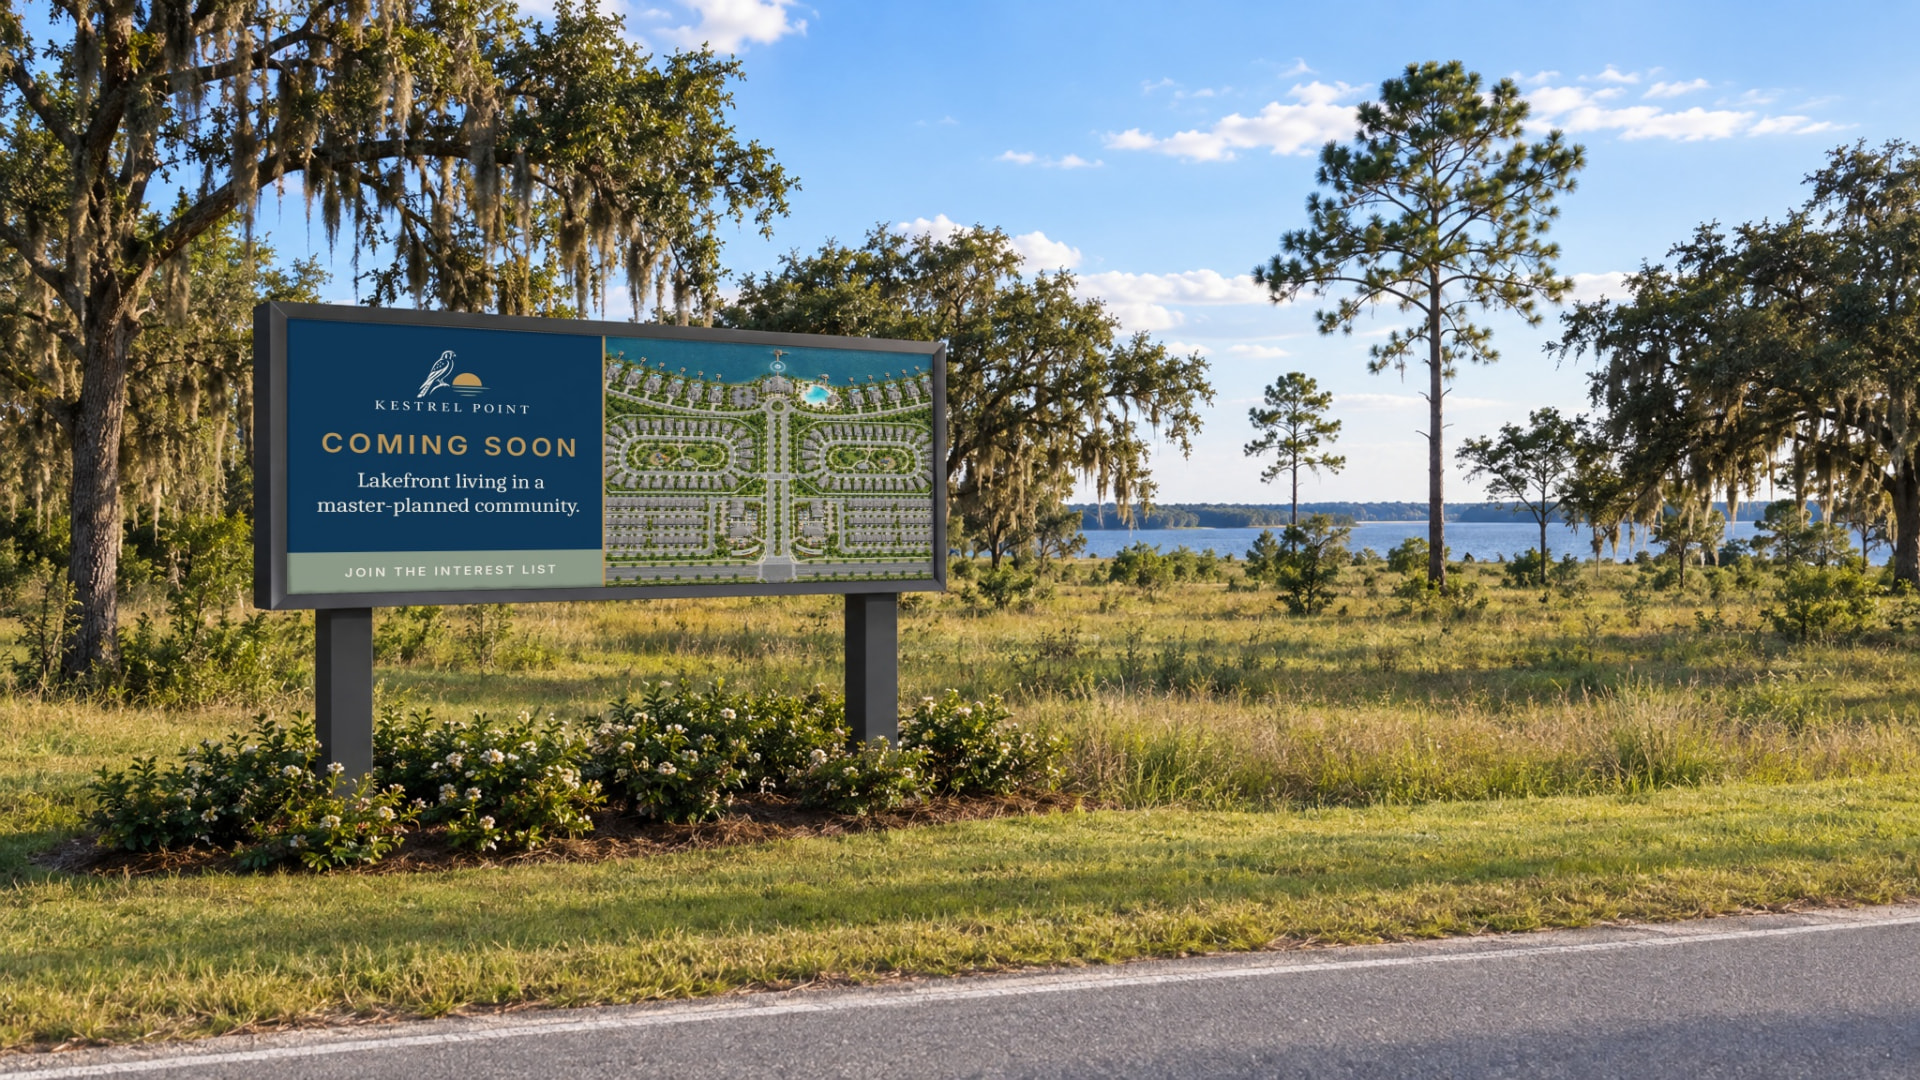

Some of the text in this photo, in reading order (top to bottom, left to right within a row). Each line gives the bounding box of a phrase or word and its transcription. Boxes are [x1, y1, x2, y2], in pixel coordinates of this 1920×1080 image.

[376, 400, 529, 414] KESTREL POINT
[322, 433, 575, 457] COMING SOON
[358, 473, 544, 492] Lakefront living in a
[317, 498, 579, 516] master-planned community.
[345, 565, 555, 577] JOIN THE INTEREST LIST
